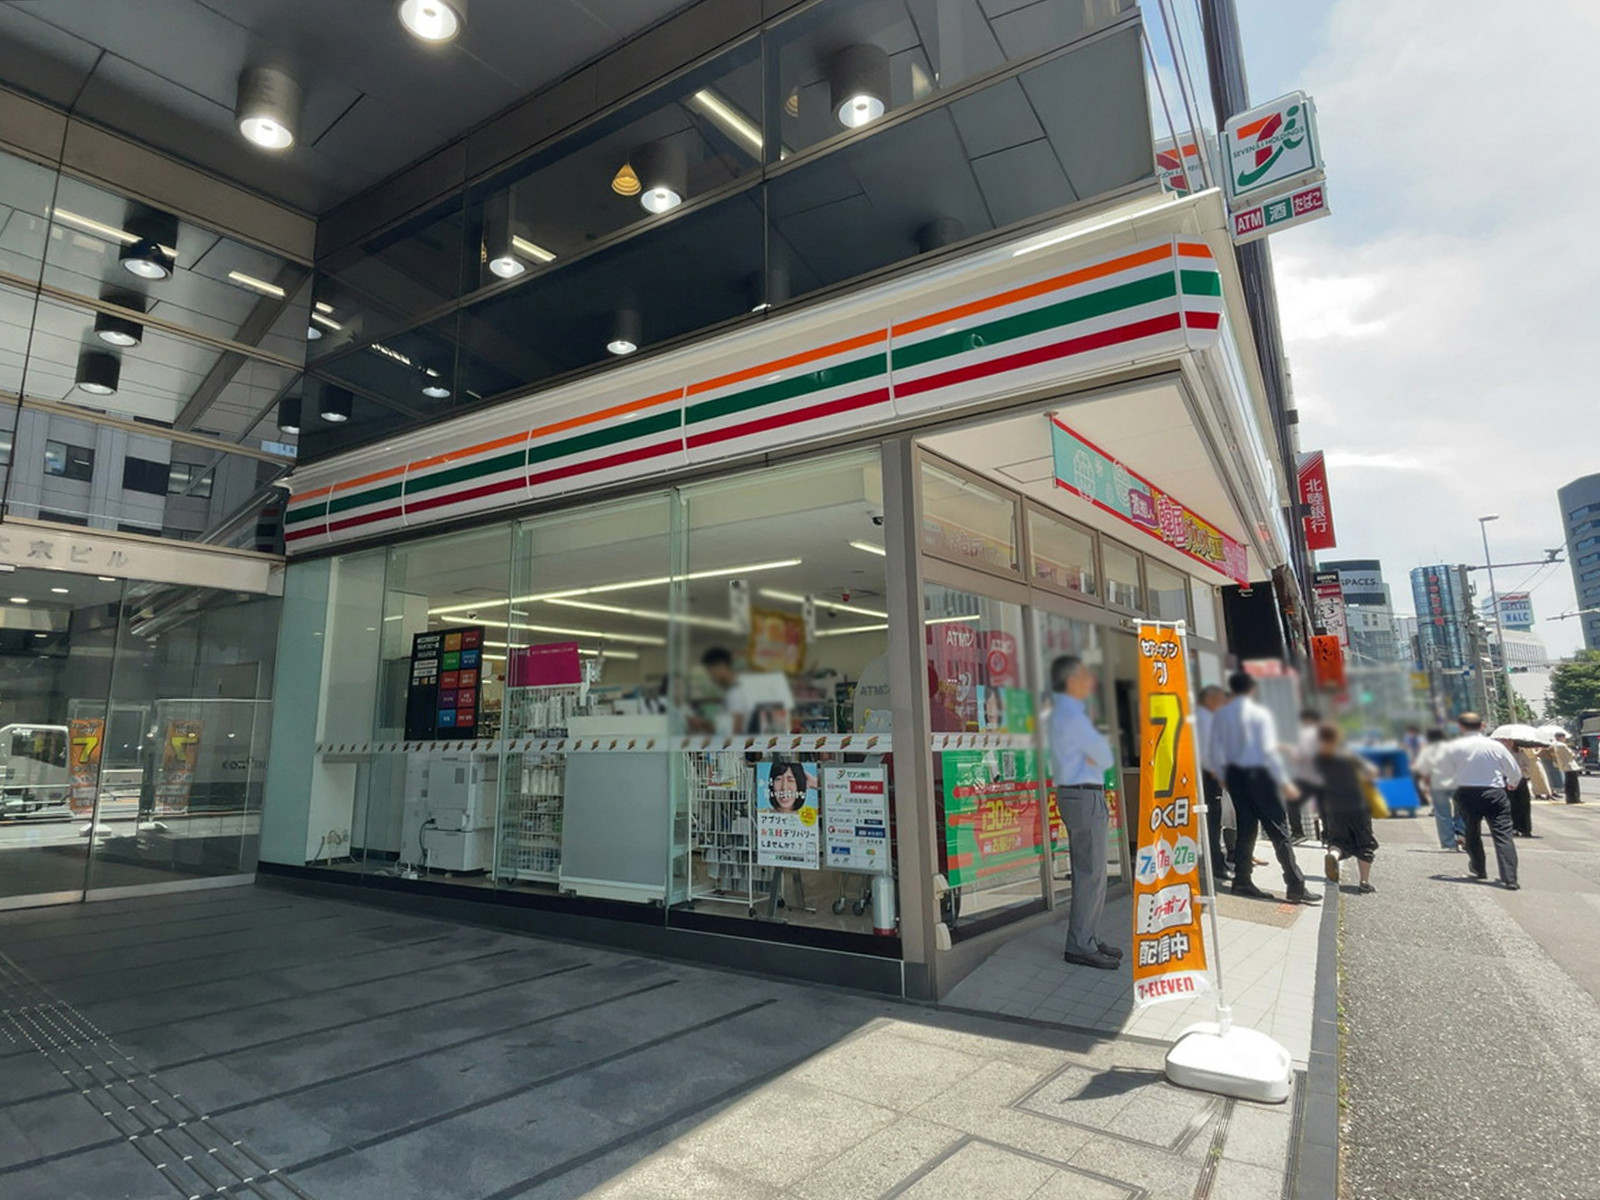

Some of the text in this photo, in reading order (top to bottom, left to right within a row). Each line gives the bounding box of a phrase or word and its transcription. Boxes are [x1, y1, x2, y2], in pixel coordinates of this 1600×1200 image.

[1268, 202, 1288, 222] 酒
[1294, 191, 1323, 213] たばこ
[1236, 211, 1263, 233] ATM
[1305, 478, 1328, 533] 北陸銀行
[1150, 693, 1182, 799] 7
[1140, 856, 1156, 874] 7日
[1174, 846, 1195, 865] 27日
[1138, 932, 1189, 968] 配信中
